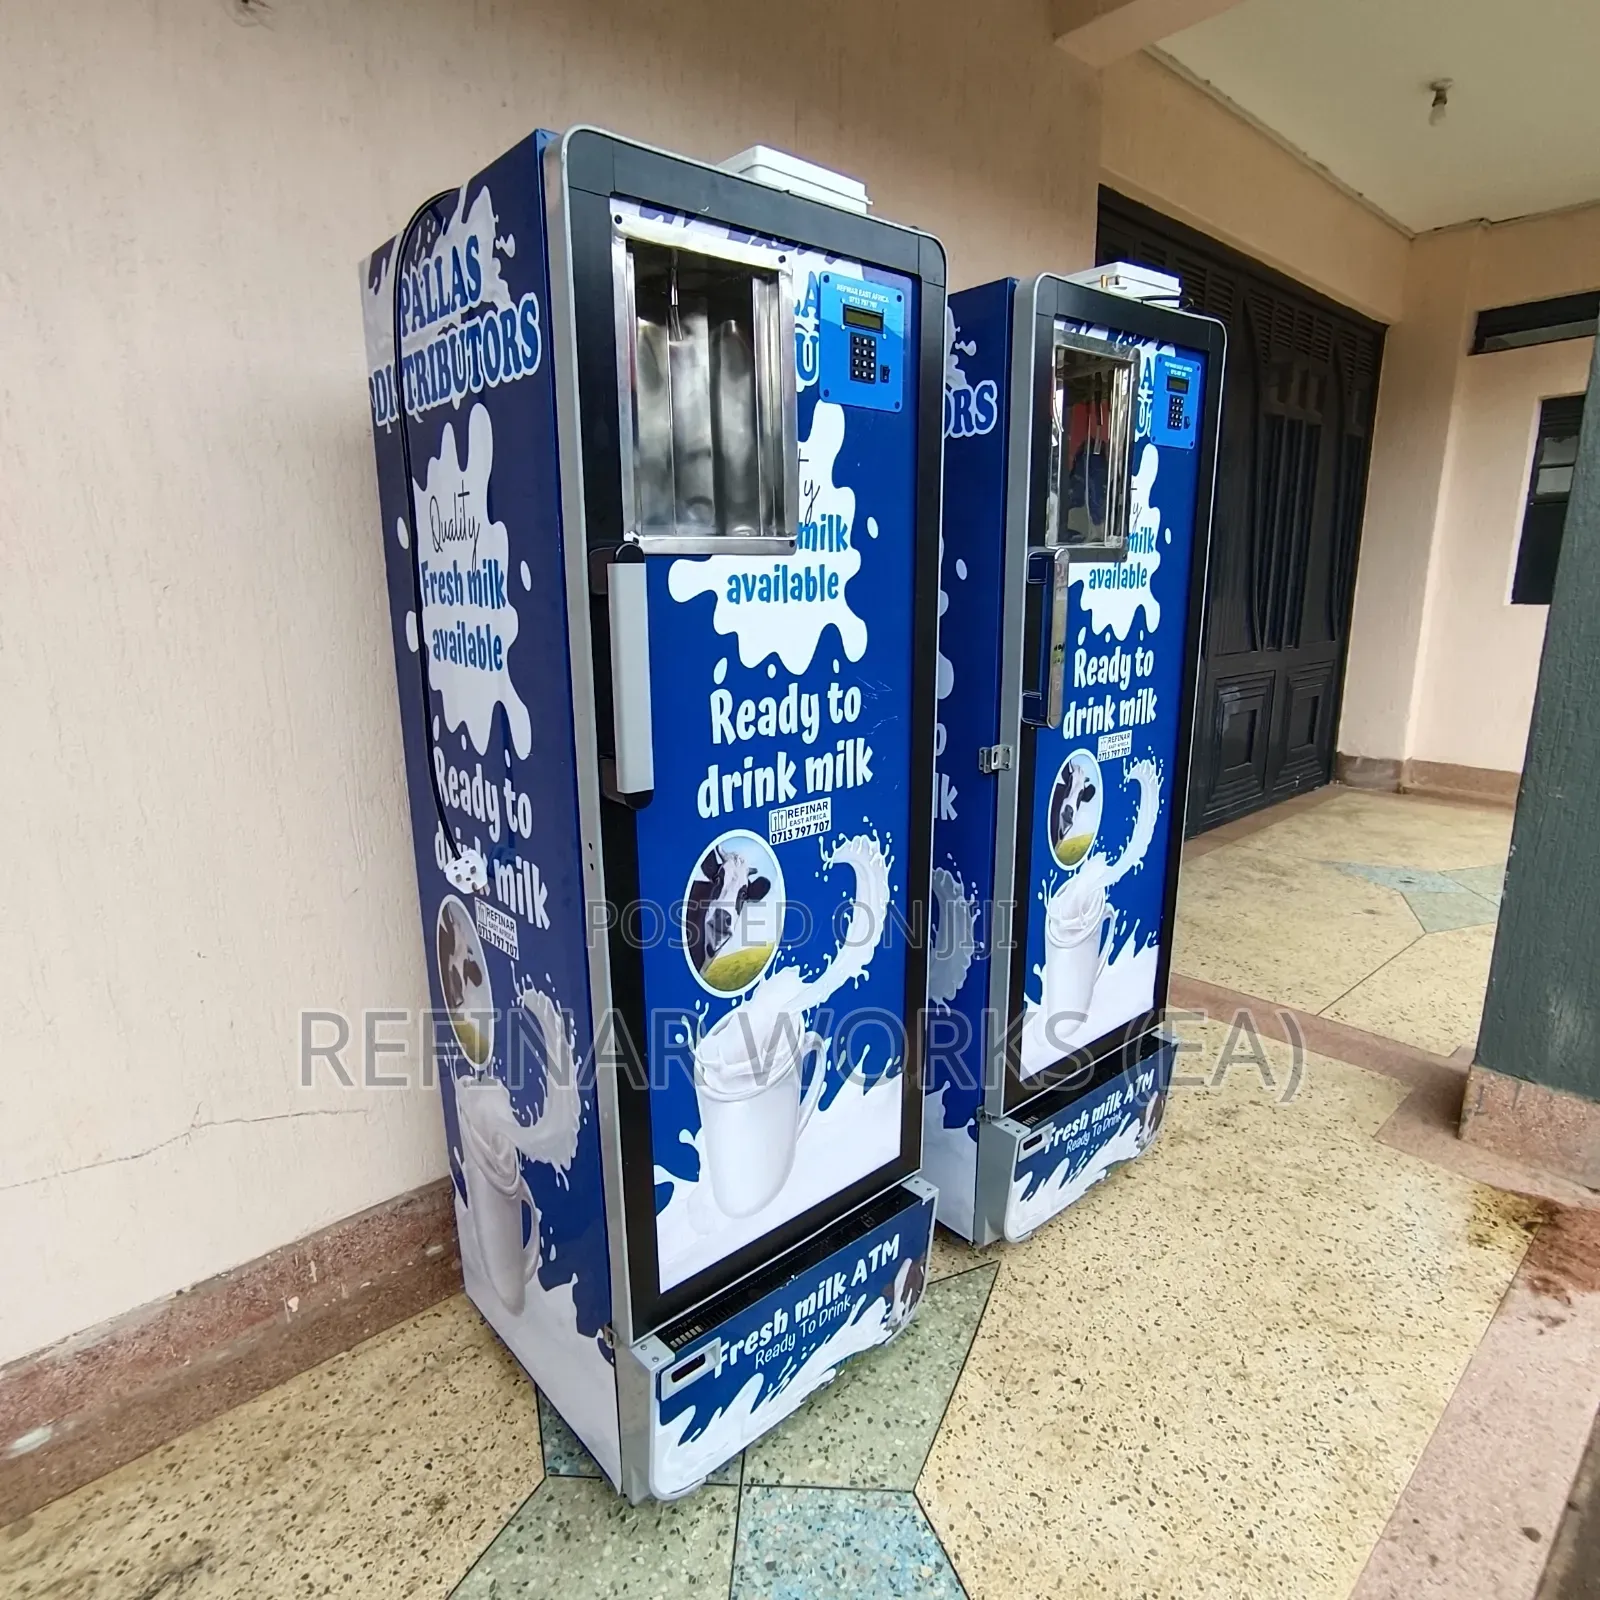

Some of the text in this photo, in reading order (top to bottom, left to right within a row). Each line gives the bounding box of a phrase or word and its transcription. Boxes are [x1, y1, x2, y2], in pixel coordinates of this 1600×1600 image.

[401, 235, 482, 338] PALLAS
[859, 288, 871, 298] EAST
[872, 292, 890, 303] AFRICA
[373, 299, 541, 422] DITRIBUTORS
[430, 480, 481, 577] Quality
[798, 514, 848, 552] milk
[1128, 526, 1154, 554] milk
[421, 558, 506, 610] Fresh milk
[727, 564, 839, 604] available
[1089, 562, 1148, 590] available
[432, 620, 504, 672] available
[1074, 646, 1154, 690] Ready to
[710, 682, 862, 745] Ready to
[1062, 688, 1158, 740] drink milk
[1108, 732, 1130, 744] REFINAR
[434, 746, 532, 843] Ready to
[697, 738, 874, 819] drink milk
[771, 820, 829, 844] 0713 797 707
[788, 801, 828, 819] REFINAR
[790, 813, 826, 826] EAST AFRICA
[494, 856, 550, 930] milk
[478, 924, 517, 958] 0713 797 707
[487, 908, 515, 933] REFINAR
[1044, 1068, 1154, 1154] Fresh milk ATM
[1066, 1110, 1122, 1154] Ready To Drink
[714, 1234, 900, 1379] Fresh milk ATM
[755, 1294, 852, 1370] Ready To Drink
